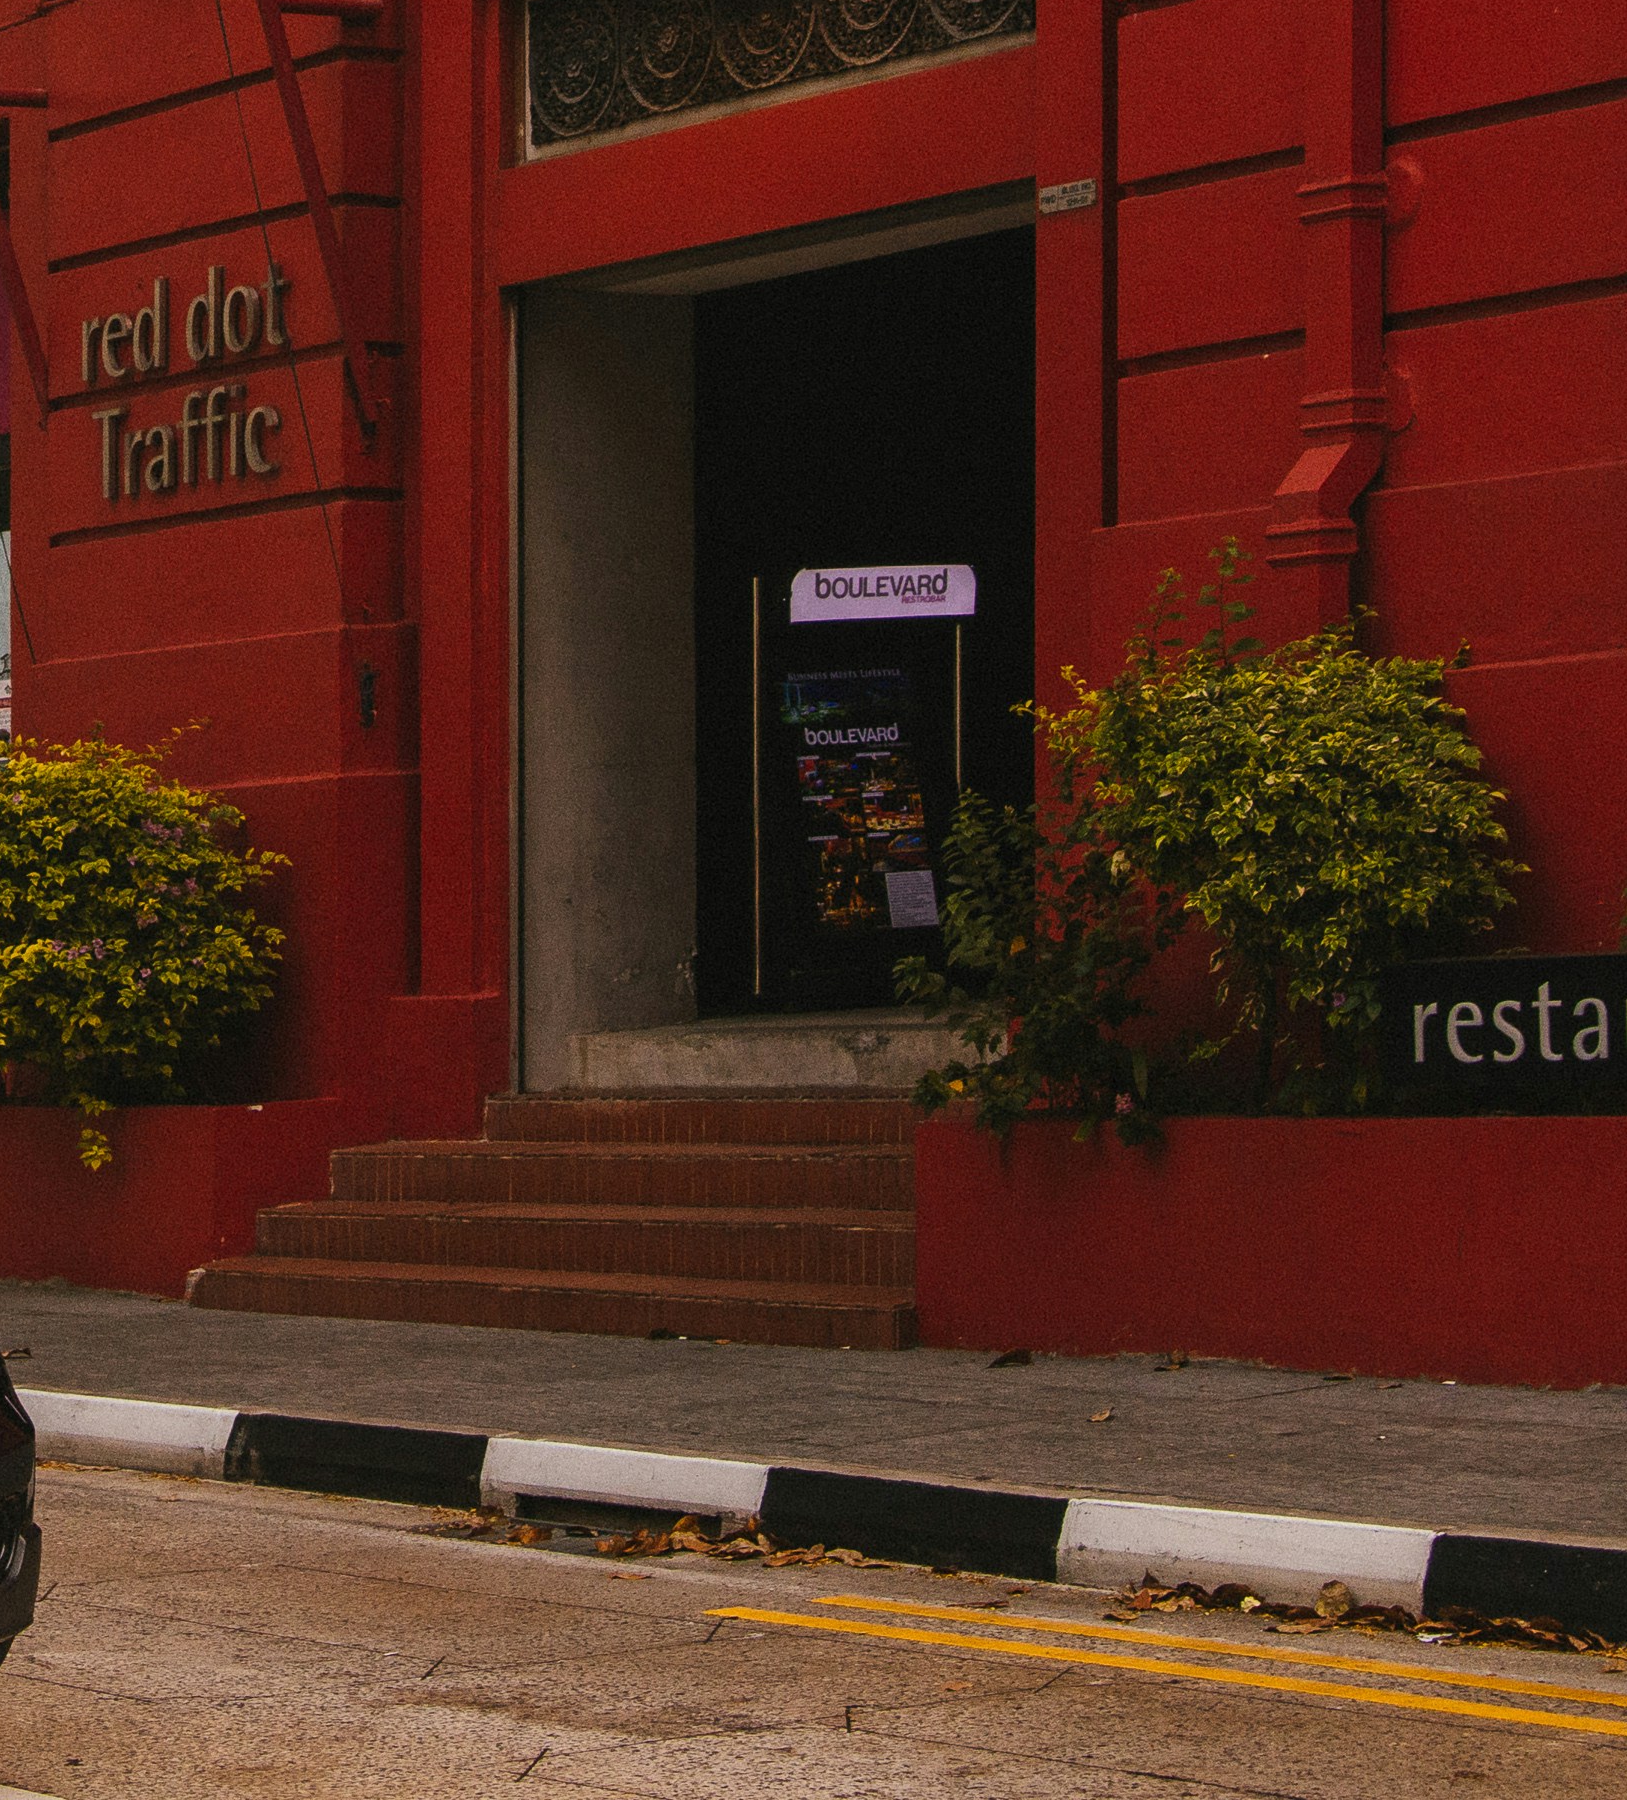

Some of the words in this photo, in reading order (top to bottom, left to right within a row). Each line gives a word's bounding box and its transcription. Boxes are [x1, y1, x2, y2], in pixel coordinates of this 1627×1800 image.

[80, 277, 169, 382] red
[185, 265, 291, 363] dot
[92, 383, 282, 501] Traffic
[901, 594, 946, 604] RESTROBAR
